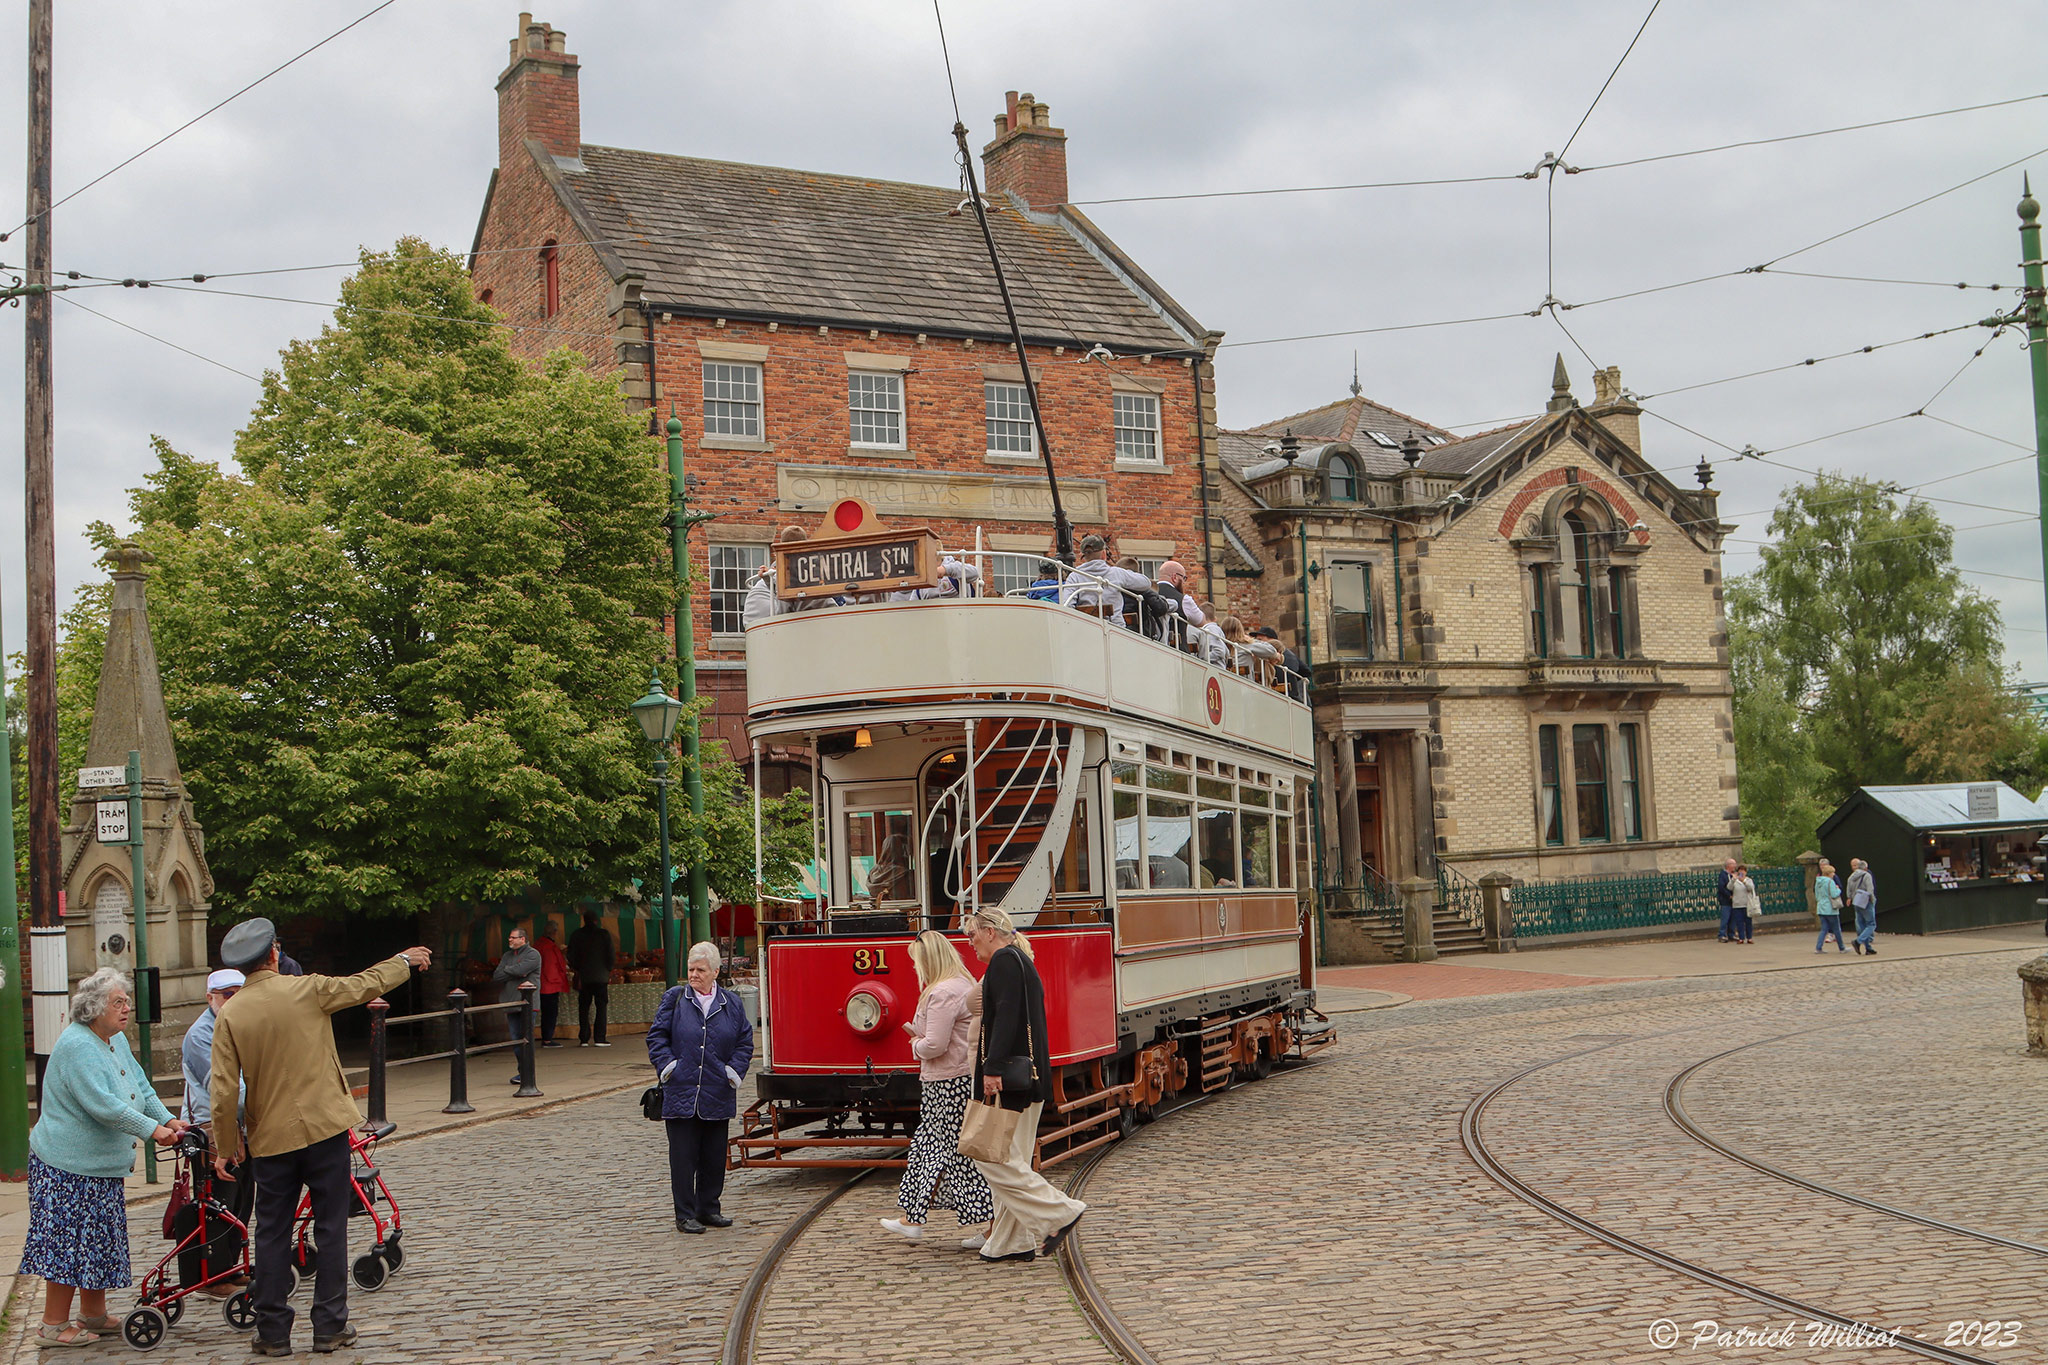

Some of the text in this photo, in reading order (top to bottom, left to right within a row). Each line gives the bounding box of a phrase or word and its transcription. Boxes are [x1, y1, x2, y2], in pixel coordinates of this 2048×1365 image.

[835, 479, 961, 506] BARCLAYS
[992, 487, 1054, 510] BANK
[797, 550, 875, 584] CENTRAL
[1208, 687, 1220, 711] 31
[85, 776, 122, 785] OTHER SIDE
[93, 769, 115, 777] STAND
[99, 809, 126, 819] TRAM
[101, 824, 125, 834] STOP
[853, 949, 890, 973] 31
